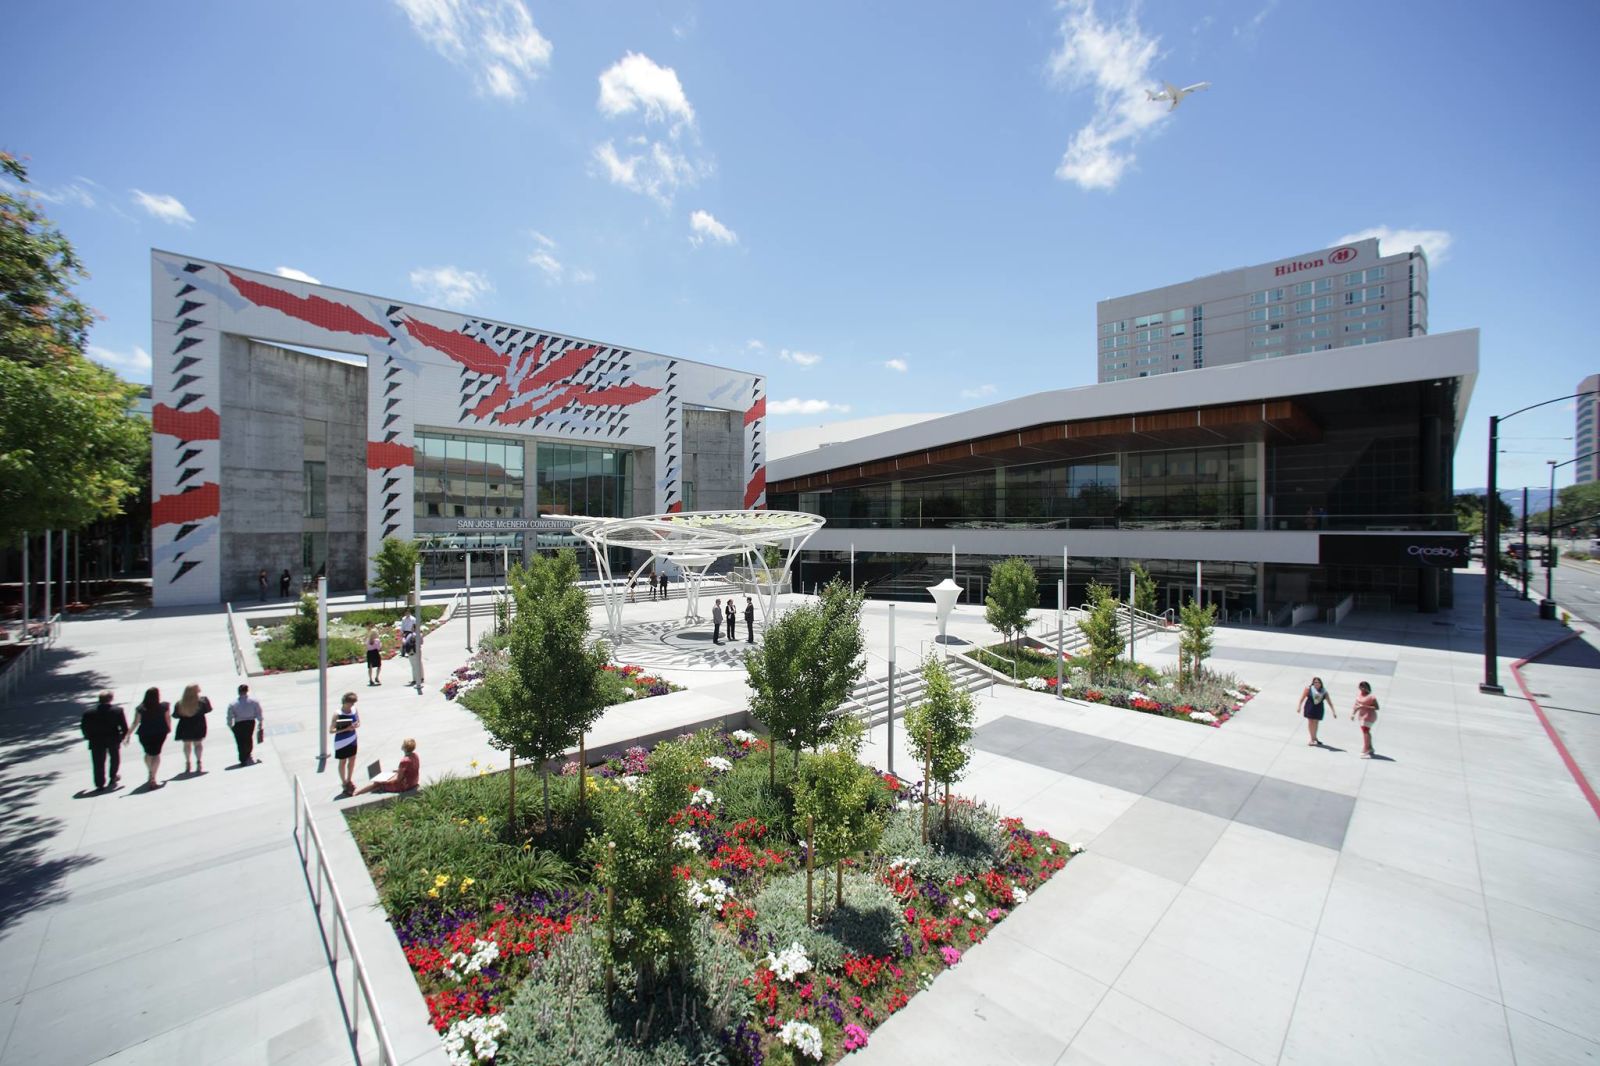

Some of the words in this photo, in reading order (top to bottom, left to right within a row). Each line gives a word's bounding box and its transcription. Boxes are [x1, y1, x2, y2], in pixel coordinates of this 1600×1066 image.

[1274, 259, 1324, 276] Hilton
[457, 520, 474, 528] SAN
[475, 520, 495, 528] JOSE
[496, 520, 529, 528] McENERY
[530, 520, 571, 528] CONVENTION
